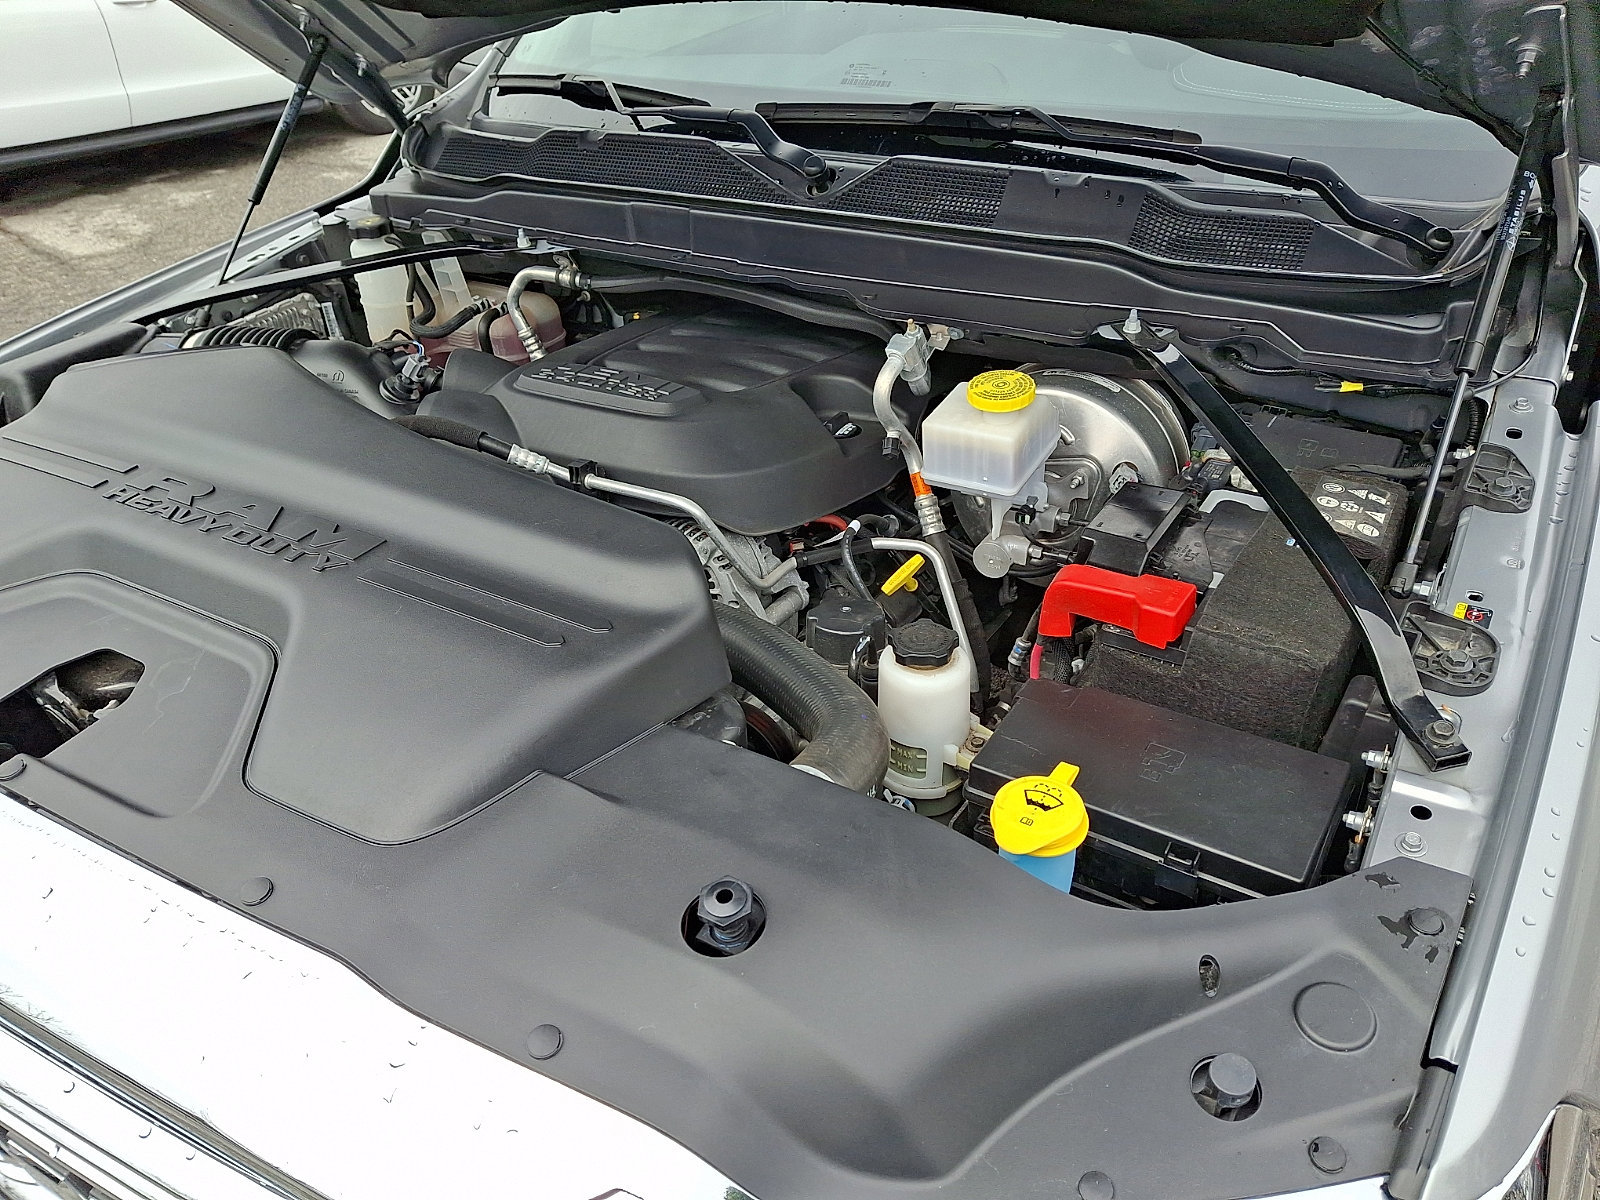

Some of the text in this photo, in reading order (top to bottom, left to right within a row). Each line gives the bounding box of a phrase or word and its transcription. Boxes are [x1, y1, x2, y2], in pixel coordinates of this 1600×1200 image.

[1508, 189, 1526, 235] STABILUS
[102, 485, 348, 572] HEAVY DUTY
[125, 471, 388, 562] RAM
[896, 747, 914, 759] MAX
[896, 760, 914, 773] MIN
